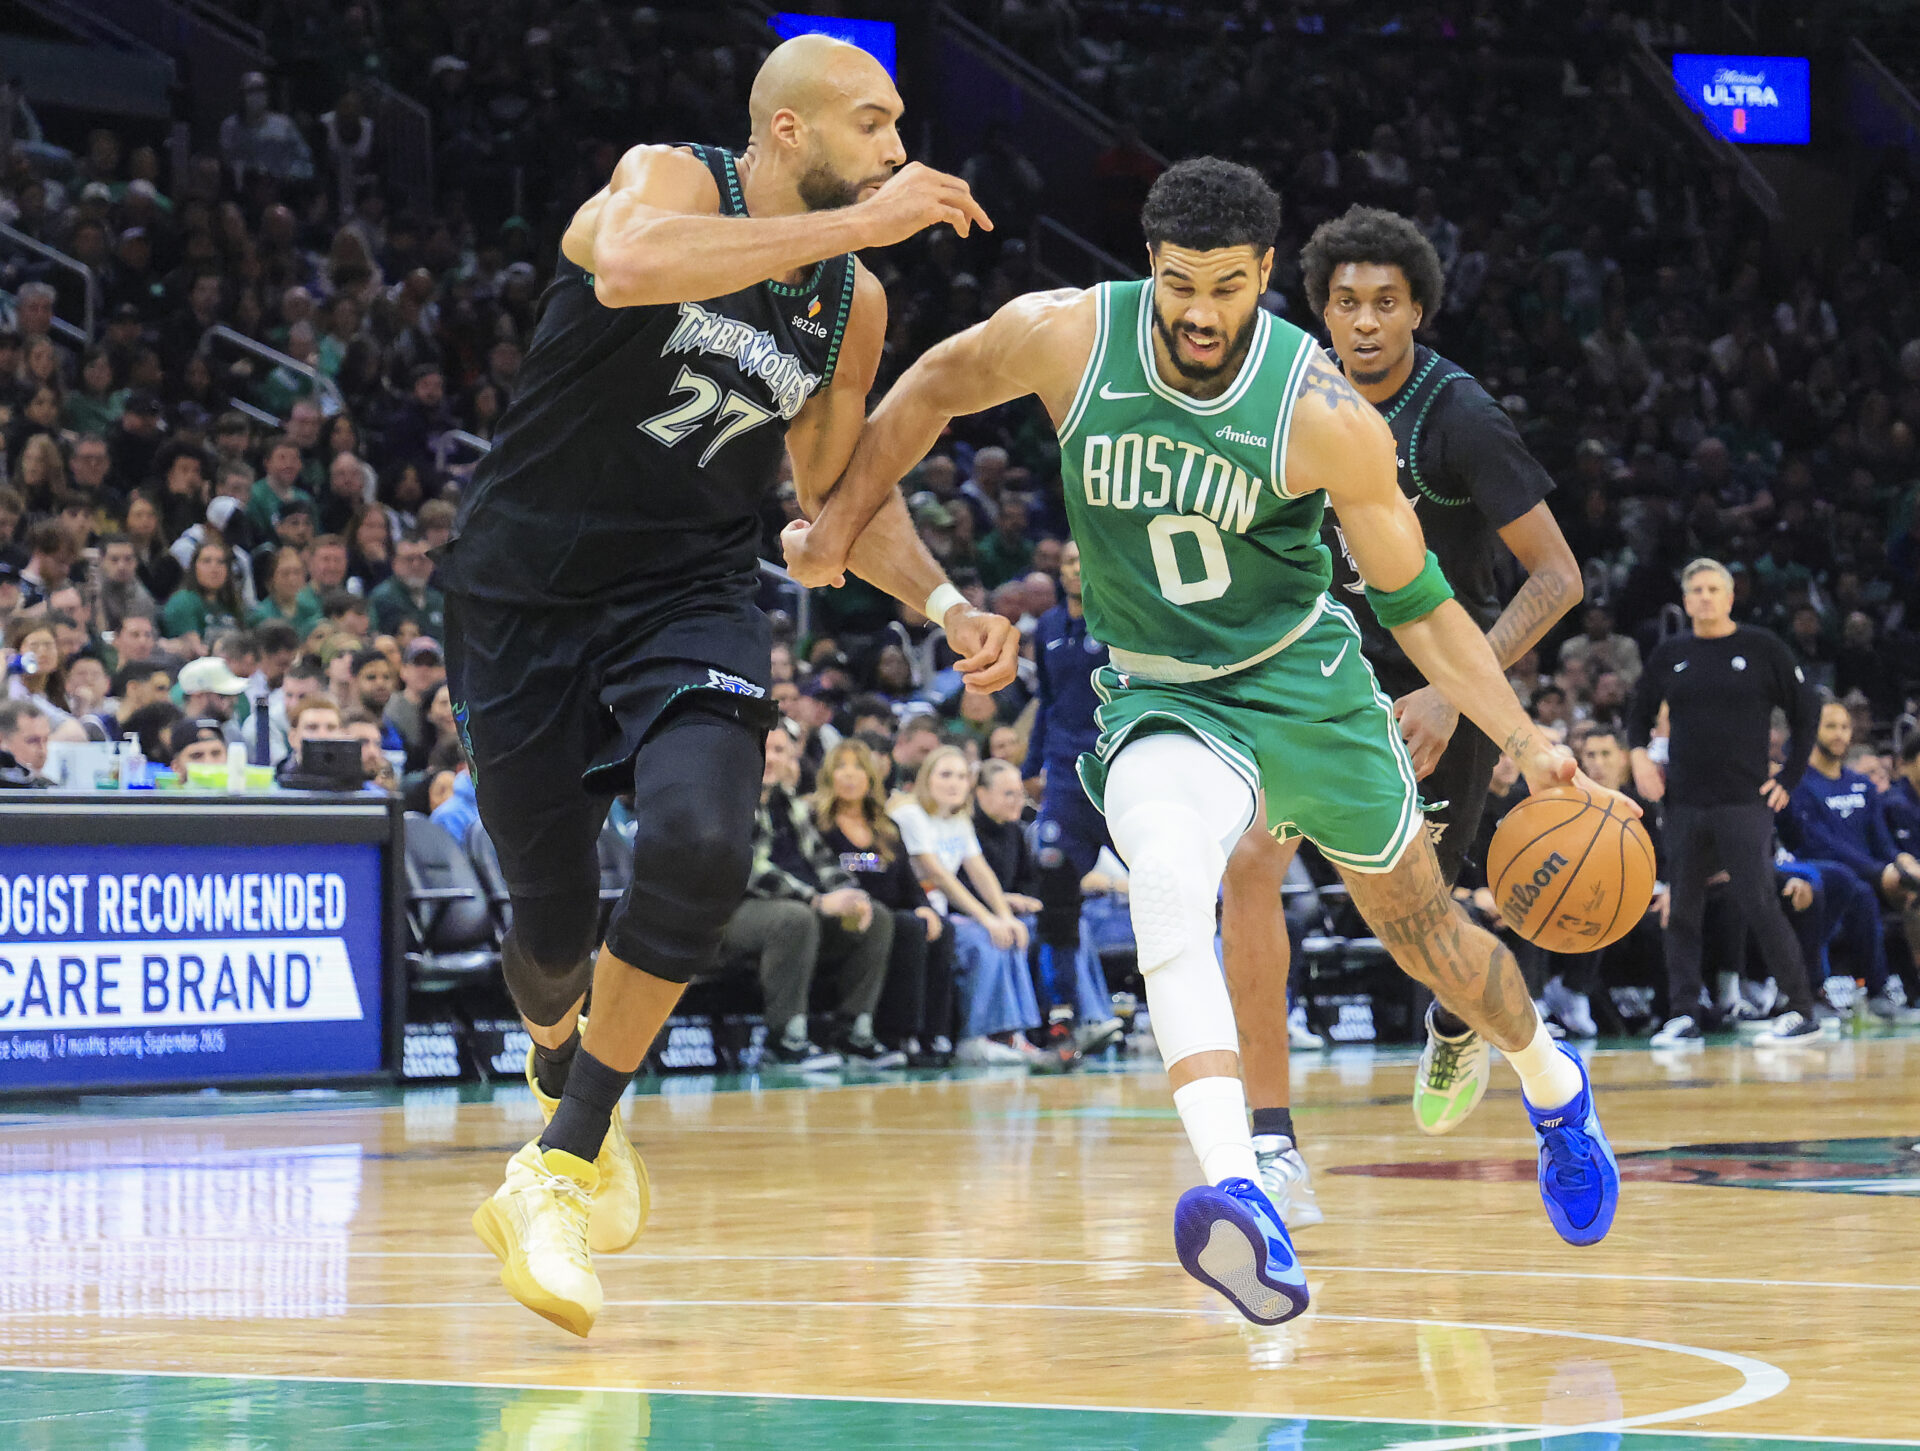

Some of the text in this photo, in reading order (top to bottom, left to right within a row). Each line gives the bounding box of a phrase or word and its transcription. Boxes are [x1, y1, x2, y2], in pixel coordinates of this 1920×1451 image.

[1703, 84, 1778, 107] ULTRA
[792, 314, 828, 339] sezzle
[636, 364, 778, 468] 27
[1215, 425, 1267, 448] Amica
[1083, 433, 1262, 534] BOSTON
[1147, 514, 1232, 605] 0
[98, 873, 346, 934] RECOMMENDED
[1501, 851, 1569, 931] Wilson
